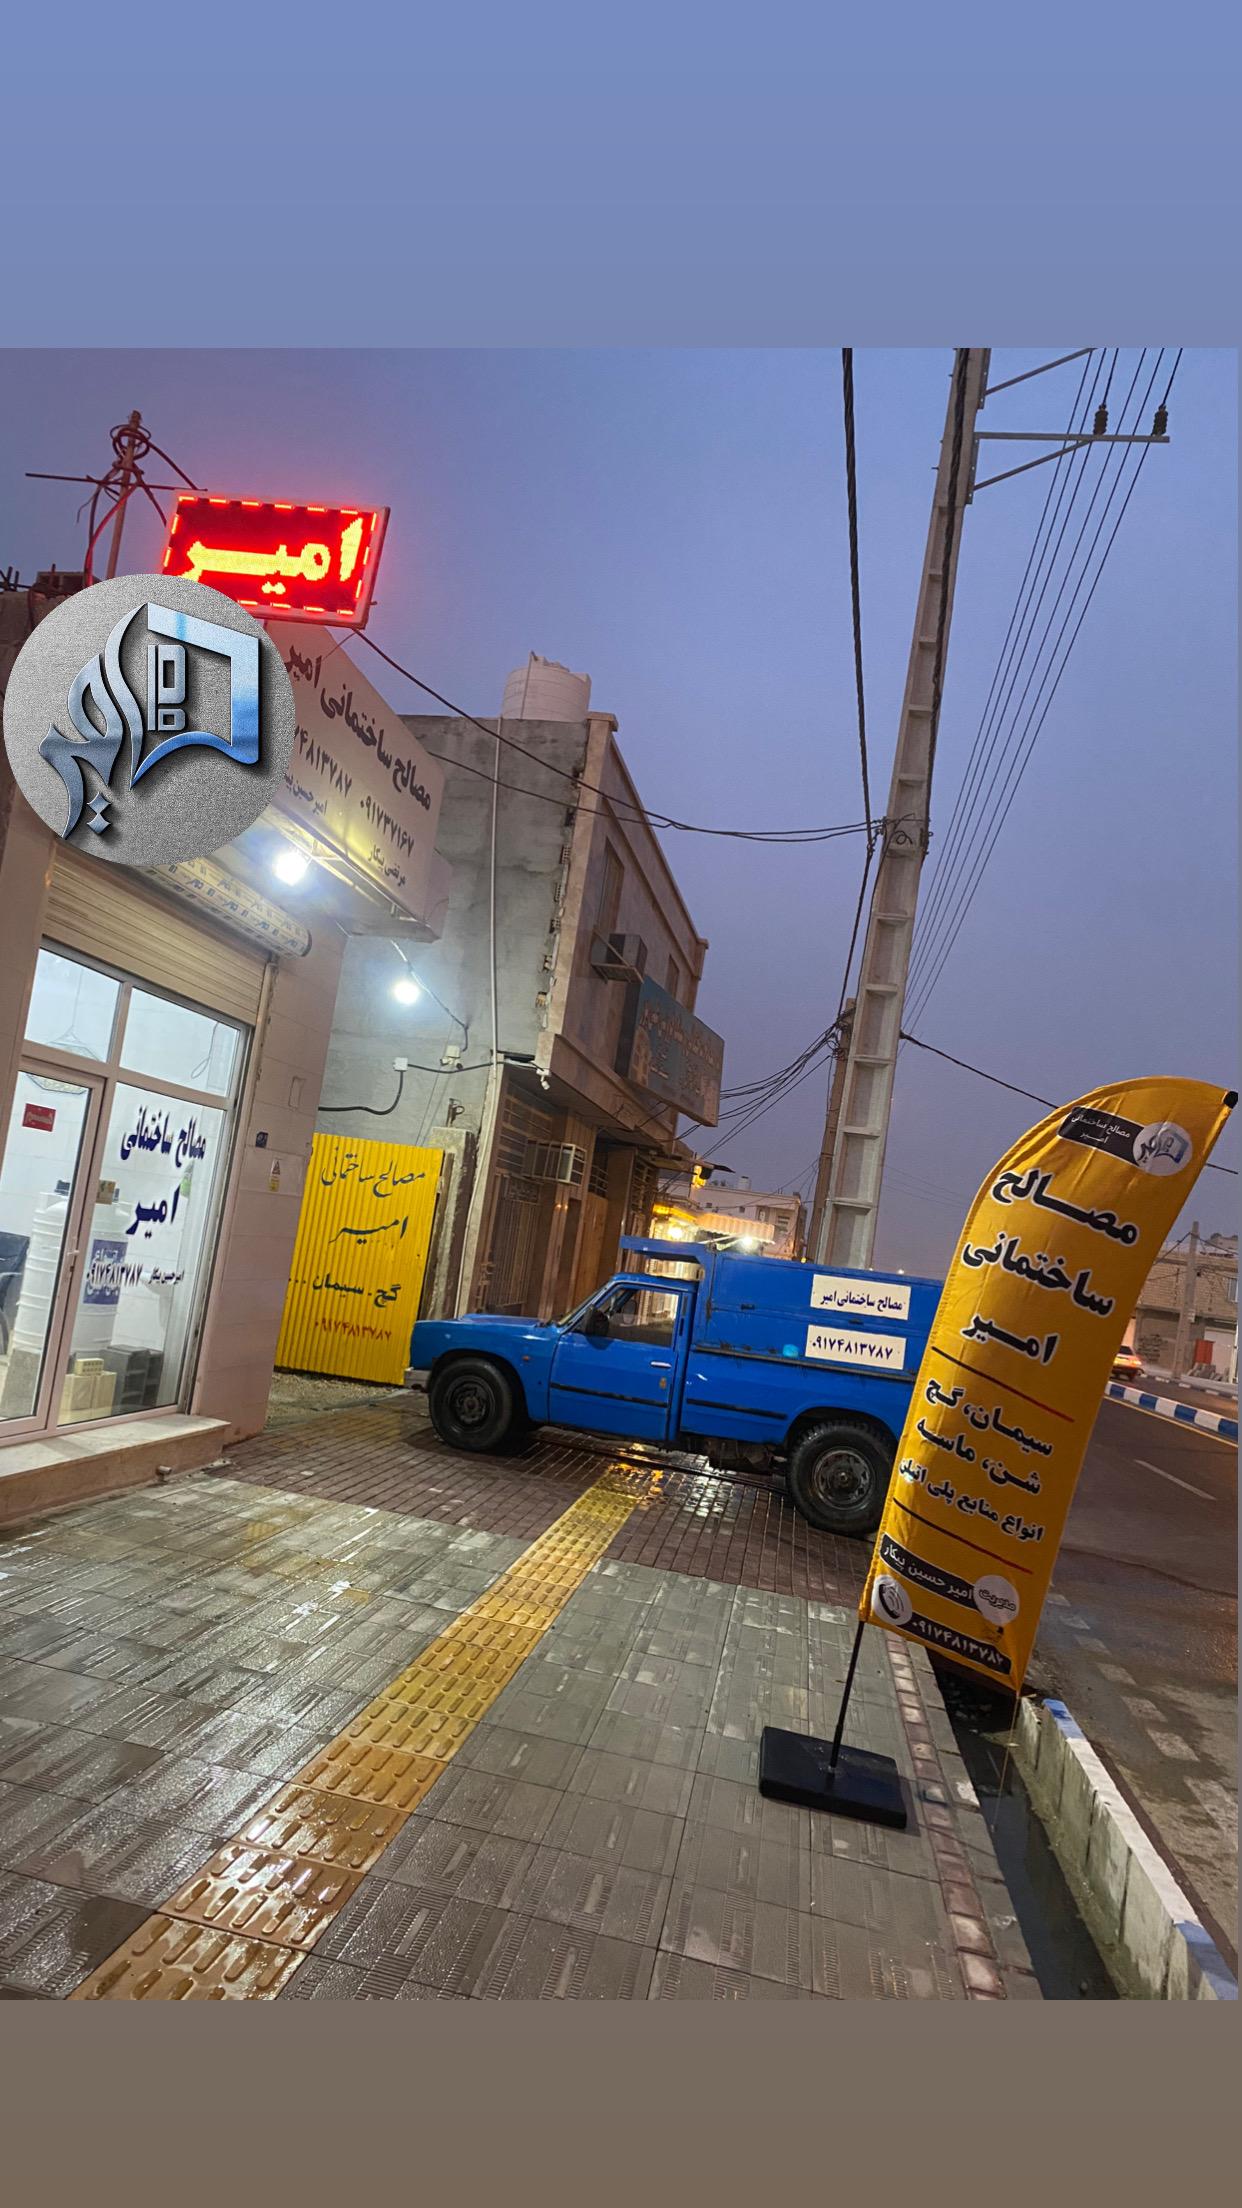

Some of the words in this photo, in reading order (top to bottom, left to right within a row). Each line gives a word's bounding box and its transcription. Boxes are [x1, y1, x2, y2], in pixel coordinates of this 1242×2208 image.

[320, 683, 393, 769] ساختمانی
[393, 757, 432, 811] مصالح
[120, 1105, 175, 1161] ساختمانی
[175, 1116, 206, 1168] مصالح
[1106, 1124, 1131, 1138] مصالح
[320, 1146, 375, 1186] ساختمانی
[373, 1159, 426, 1198] مصالح
[125, 1183, 181, 1239] امیر
[991, 1168, 1139, 1245] مصالح
[328, 1216, 409, 1244] امیر
[313, 1273, 364, 1298] سیمان
[962, 1232, 1115, 1317] ساختمانی
[820, 1290, 838, 1305] امیر
[837, 1291, 875, 1309] ساختمانی
[876, 1297, 903, 1312] مصالح
[812, 1335, 894, 1360] ۰۹۱۷۴۸۱۳۷۸۷
[962, 1315, 1059, 1364] امیر
[925, 1379, 965, 1408] گچ
[917, 1418, 976, 1463] ماسه
[927, 1481, 955, 1505] پلی
[1001, 1514, 1044, 1541] انواع
[883, 1543, 906, 1572] پیکار
[907, 1562, 946, 1587] حسین
[948, 1585, 974, 1600] امیر
